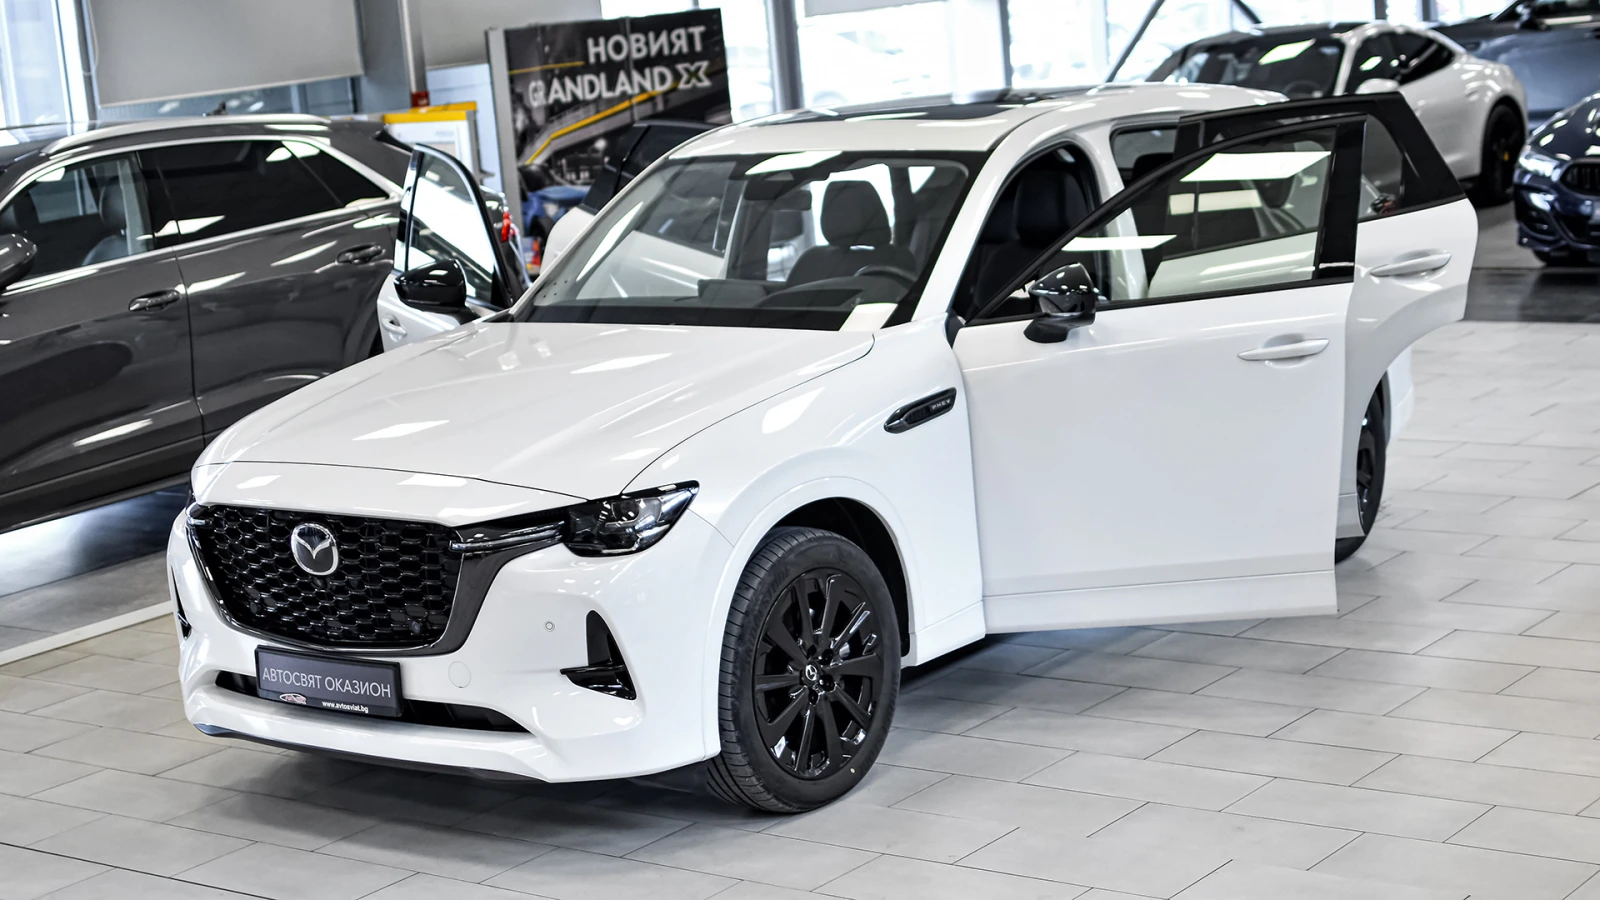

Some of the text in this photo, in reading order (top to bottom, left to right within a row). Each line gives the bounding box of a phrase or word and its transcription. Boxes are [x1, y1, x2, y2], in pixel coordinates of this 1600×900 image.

[587, 26, 706, 64] НОВИЯТ
[262, 667, 391, 698] АВТОСВЯТ ОКАЗИОН
[322, 701, 369, 713] www.avtosviat.bg
